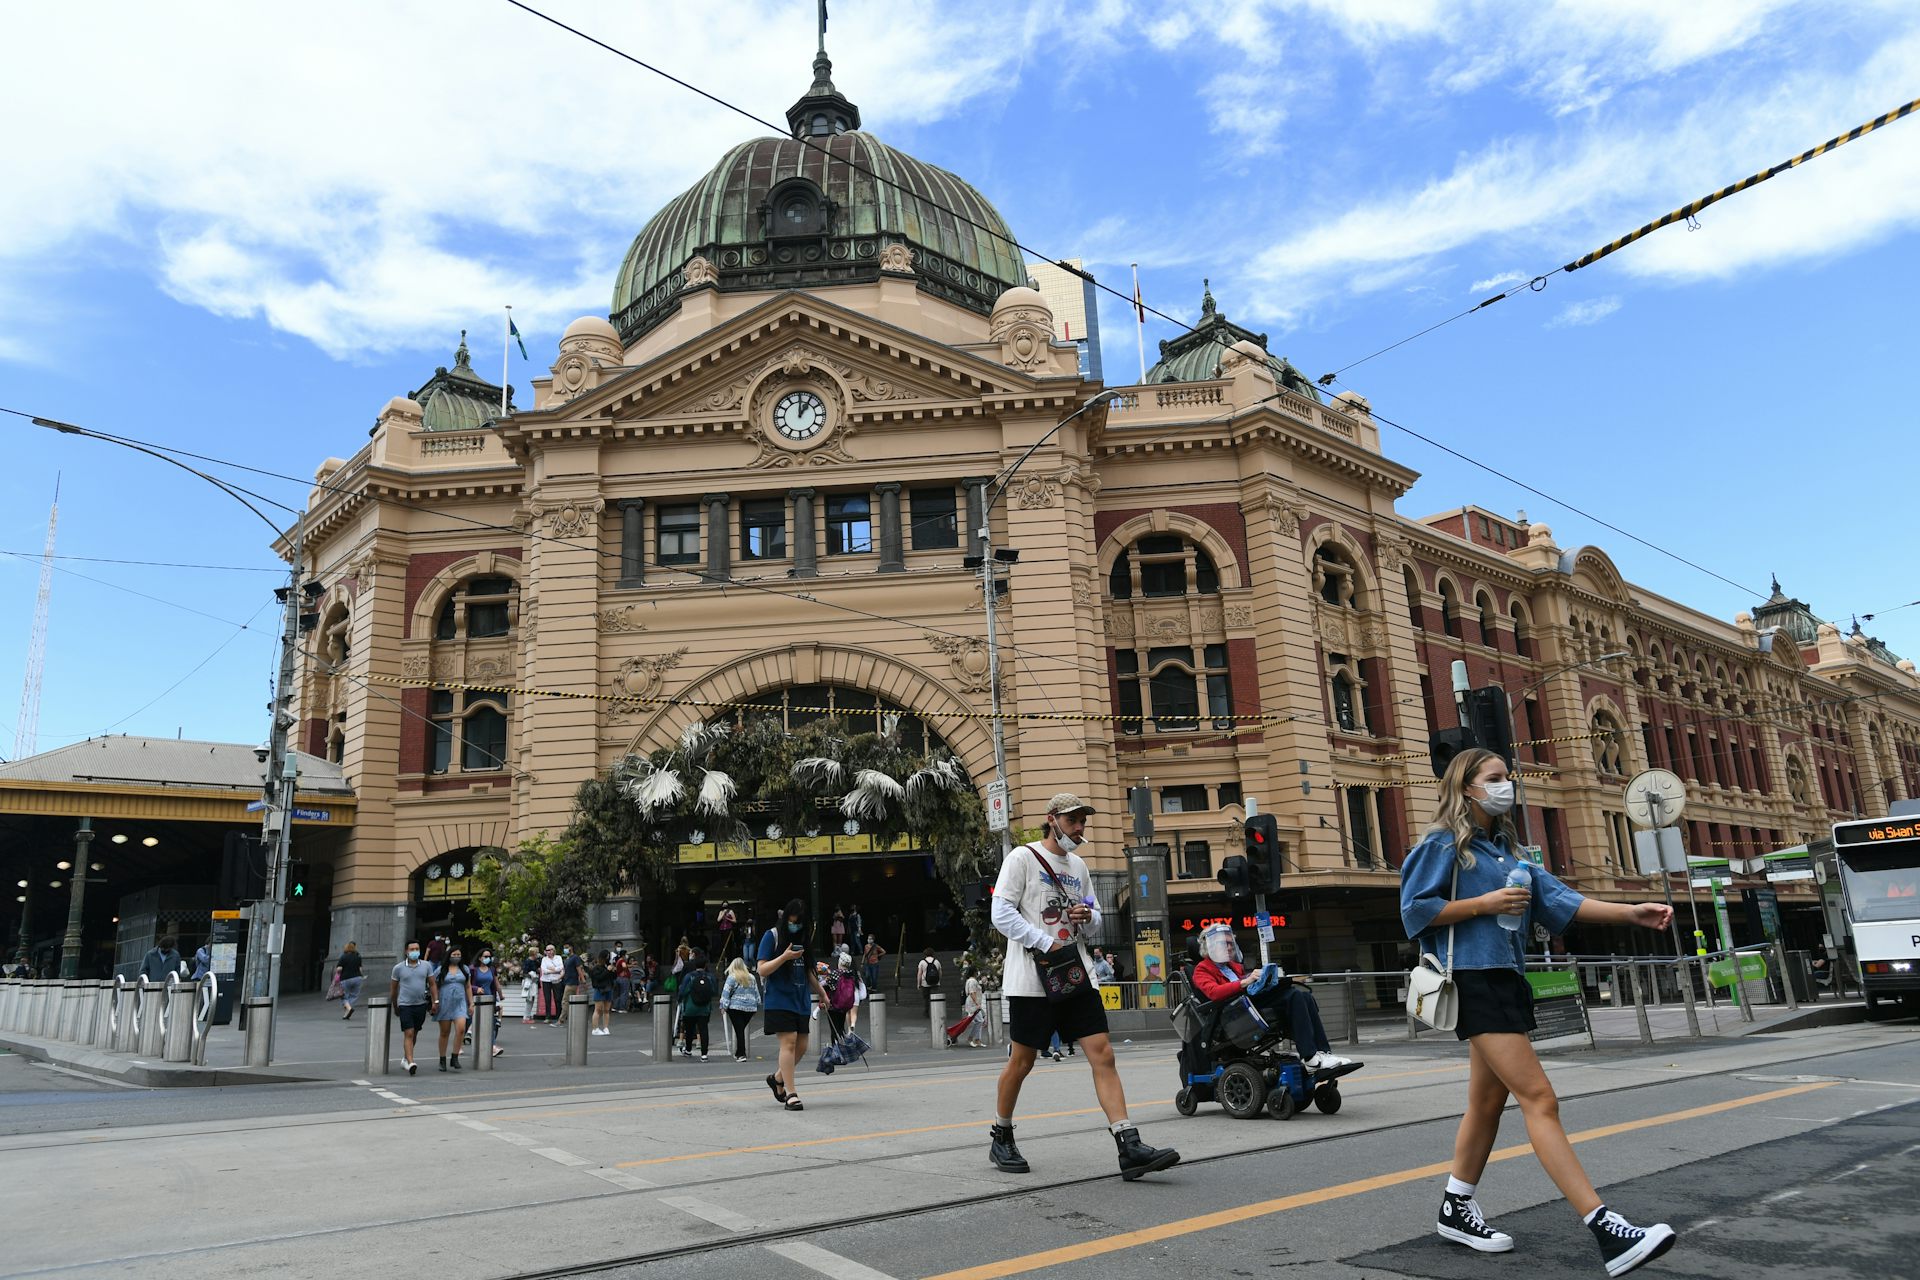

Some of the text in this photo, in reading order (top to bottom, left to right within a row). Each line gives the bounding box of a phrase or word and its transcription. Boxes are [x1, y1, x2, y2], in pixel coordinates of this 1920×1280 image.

[296, 809, 320, 817] Flinders
[1868, 823, 1920, 840] via Swan S
[1200, 917, 1233, 929] CITY
